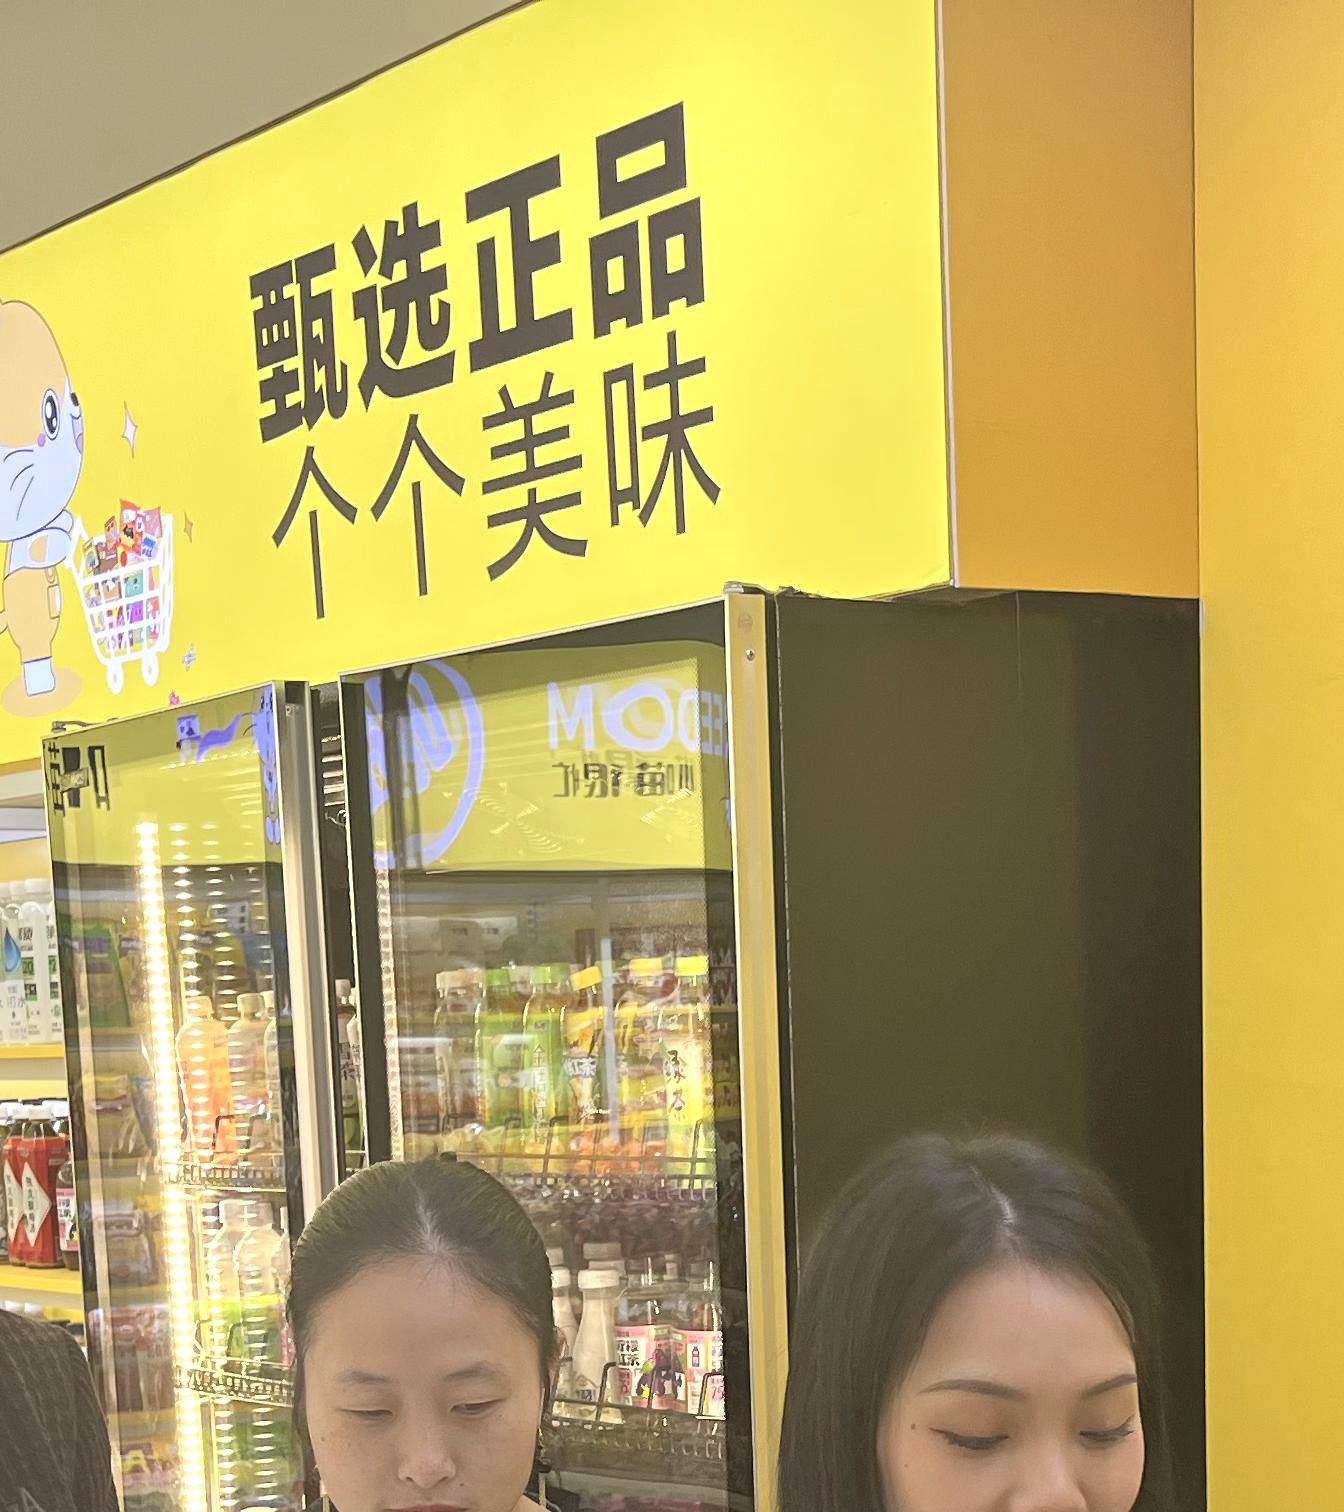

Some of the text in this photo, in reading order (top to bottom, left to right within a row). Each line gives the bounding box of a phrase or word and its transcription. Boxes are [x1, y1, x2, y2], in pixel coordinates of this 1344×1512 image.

[249, 101, 706, 443] 甄选正品
[271, 331, 722, 620] 个个美味
